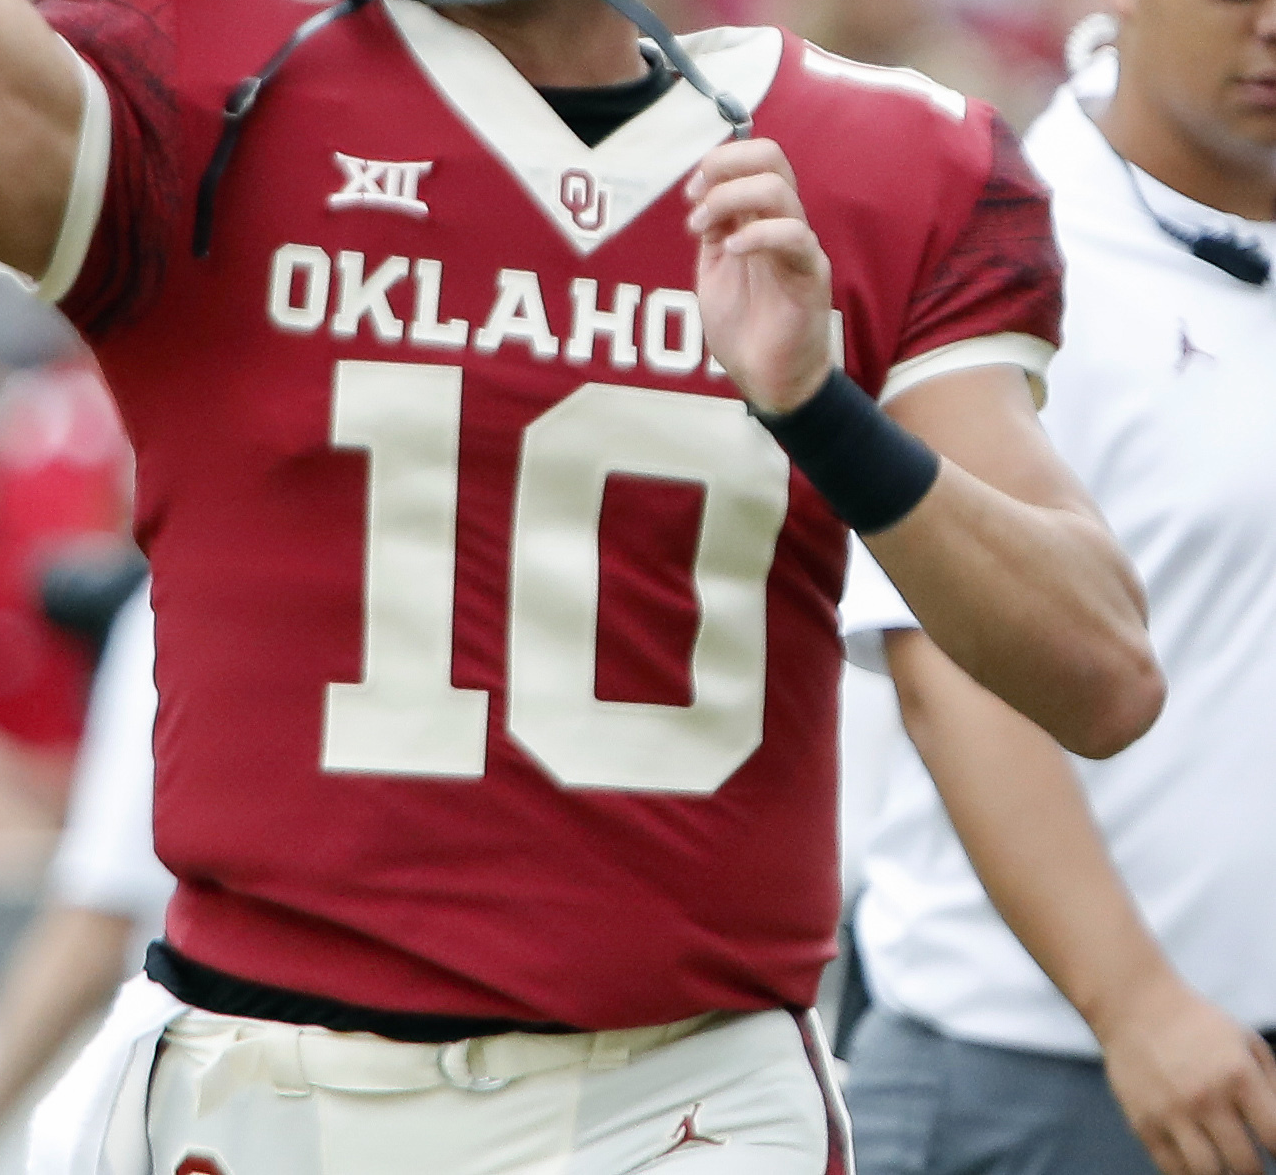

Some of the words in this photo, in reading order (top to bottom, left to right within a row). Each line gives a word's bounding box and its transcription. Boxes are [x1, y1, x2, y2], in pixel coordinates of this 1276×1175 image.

[329, 151, 434, 215] XII
[559, 168, 609, 231] OU
[269, 241, 845, 376] OKLAHO
[321, 359, 791, 795] 10
